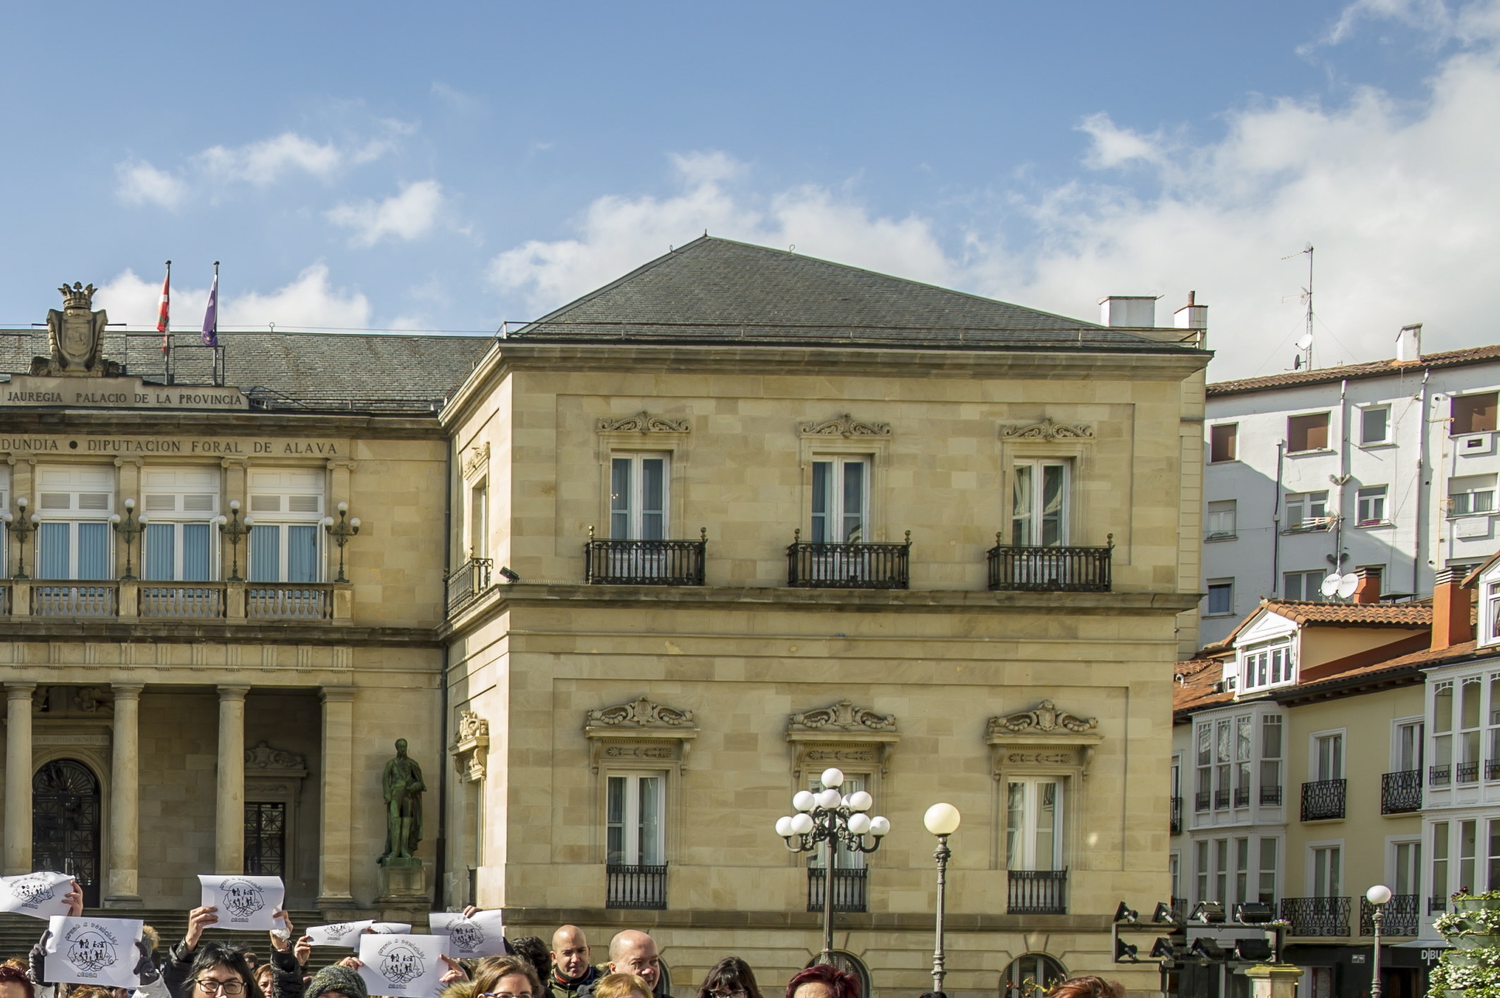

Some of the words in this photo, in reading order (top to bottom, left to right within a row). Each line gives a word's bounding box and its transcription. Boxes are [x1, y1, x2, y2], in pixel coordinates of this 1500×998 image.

[7, 392, 63, 403] JAUREGIA
[75, 393, 127, 404] PALACIO
[134, 393, 149, 404] DE
[156, 394, 172, 404] LA
[179, 394, 242, 405] PROVINCIA
[87, 440, 181, 452] DIPUTACION
[191, 441, 242, 453] FORAL
[253, 442, 272, 453] DE
[283, 443, 338, 454] ALAVA
